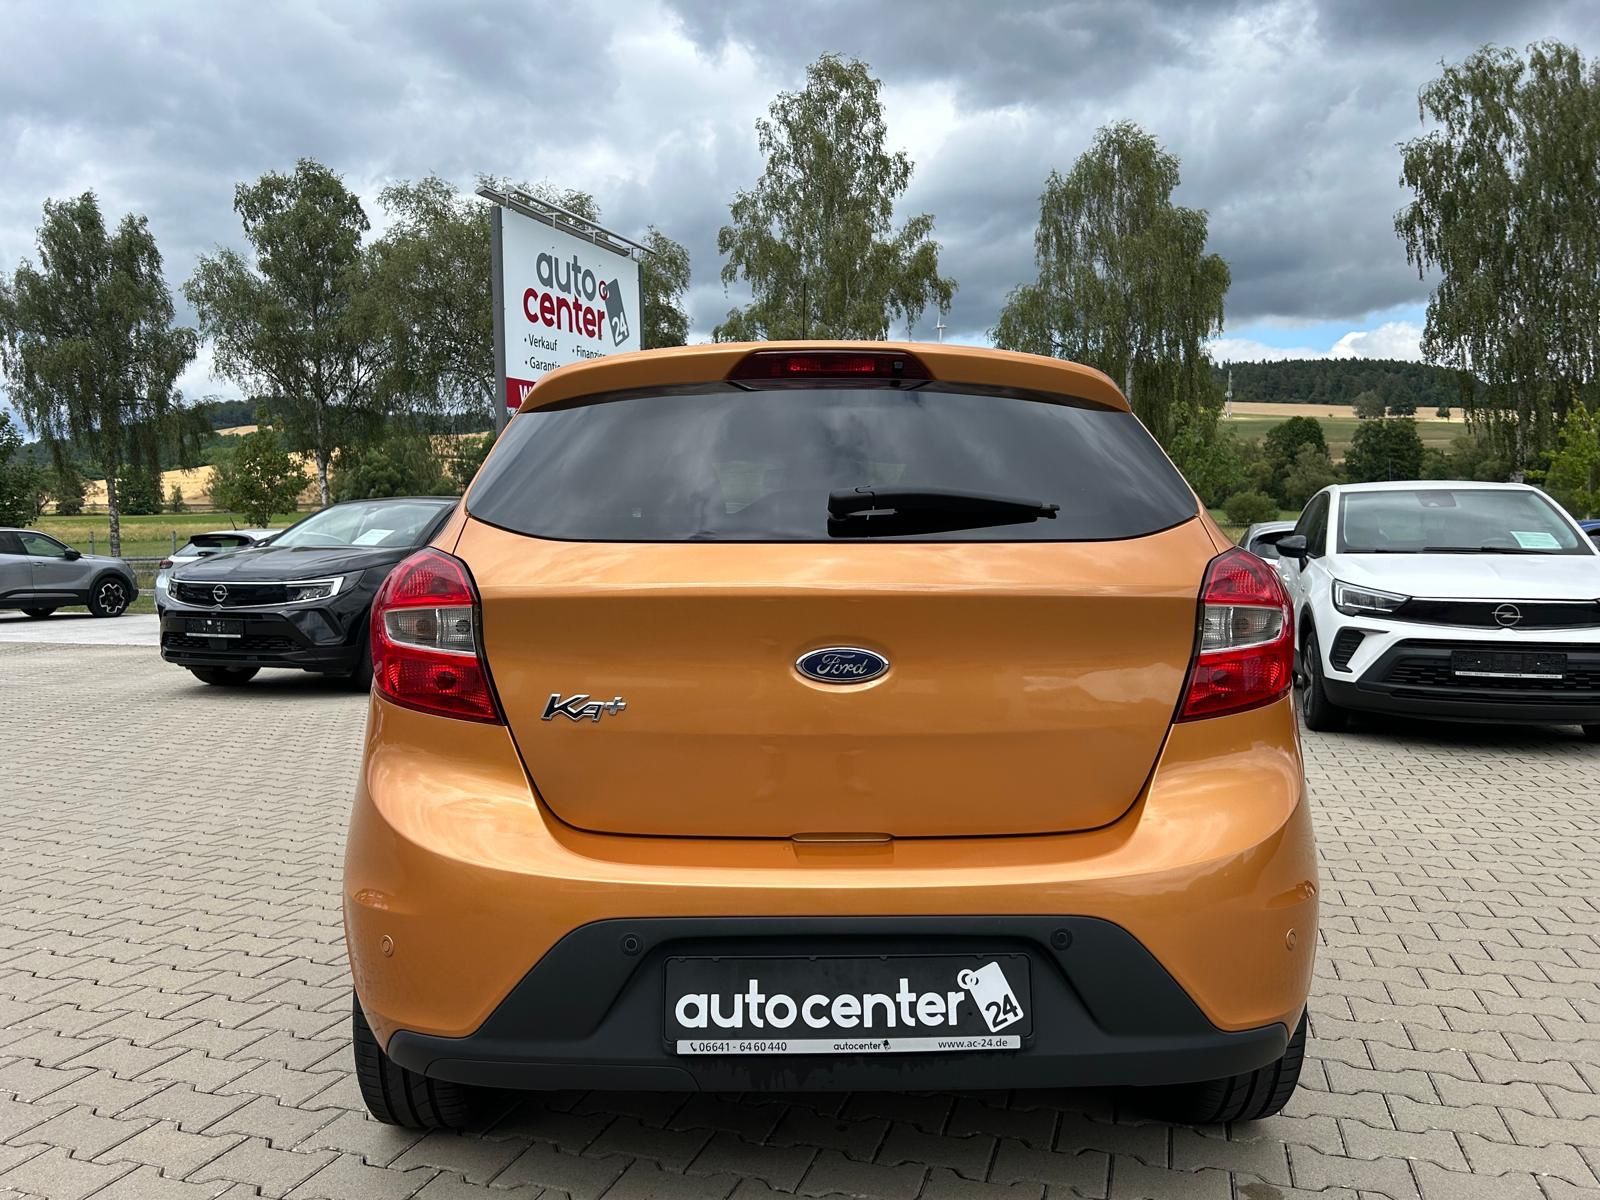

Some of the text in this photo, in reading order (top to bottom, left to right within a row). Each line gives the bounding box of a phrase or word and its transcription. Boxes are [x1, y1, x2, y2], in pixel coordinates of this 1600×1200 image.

[536, 252, 597, 302] auto
[523, 287, 606, 341] center
[611, 311, 628, 343] 24
[528, 333, 558, 352] Verkauf
[816, 653, 869, 675] Ford
[985, 993, 1019, 1028] 24
[699, 1041, 730, 1052] 06641
[833, 1041, 881, 1051] autocenter
[938, 1038, 1008, 1049] www.ac-24.de
